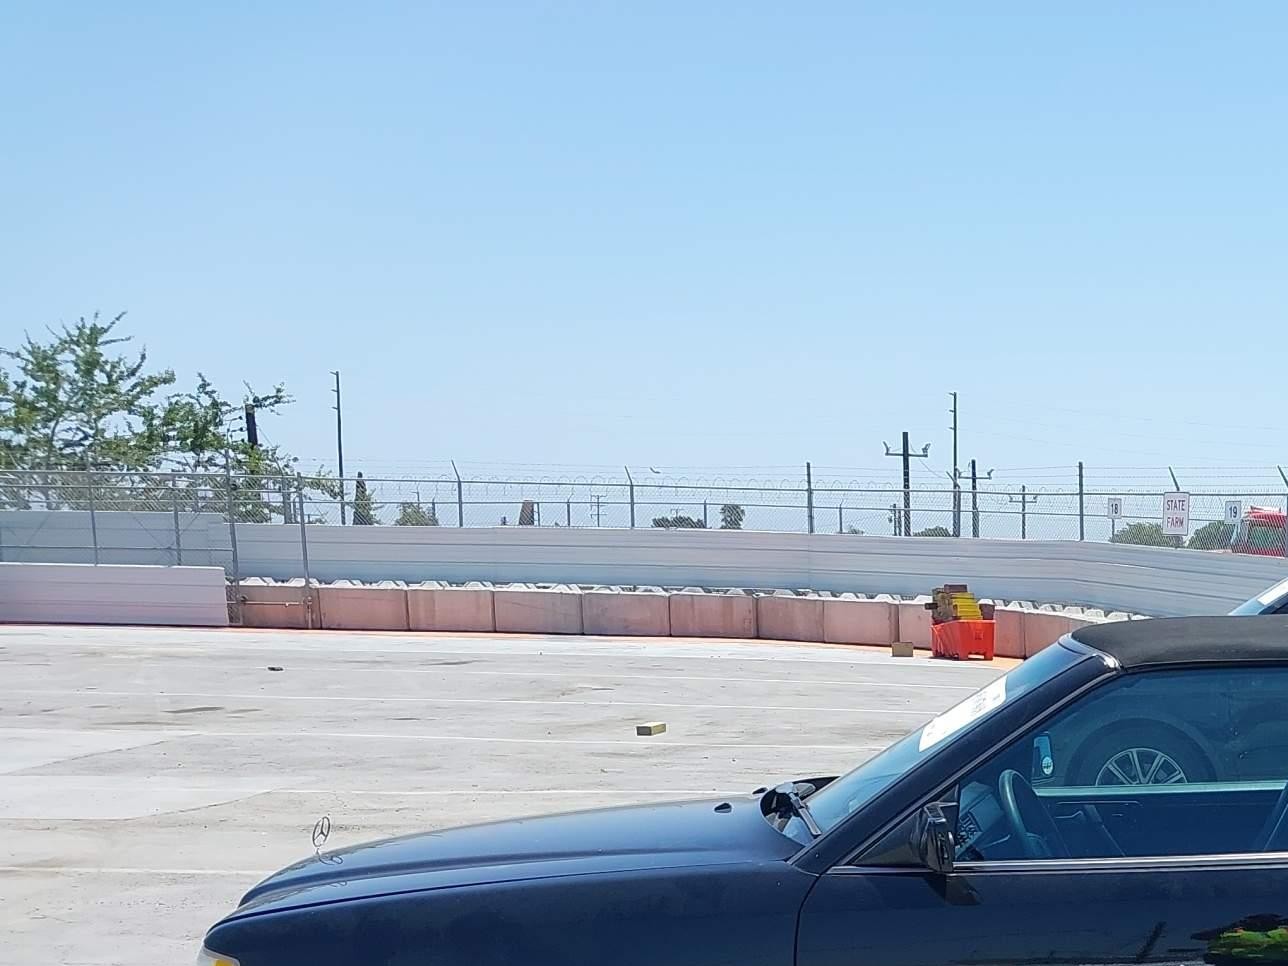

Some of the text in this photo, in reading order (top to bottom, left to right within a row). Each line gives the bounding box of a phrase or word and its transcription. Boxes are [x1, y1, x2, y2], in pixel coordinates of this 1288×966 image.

[1110, 503, 1119, 515] 18
[1166, 499, 1186, 512] STATE
[1228, 505, 1238, 519] 19
[1166, 516, 1184, 528] FARM
